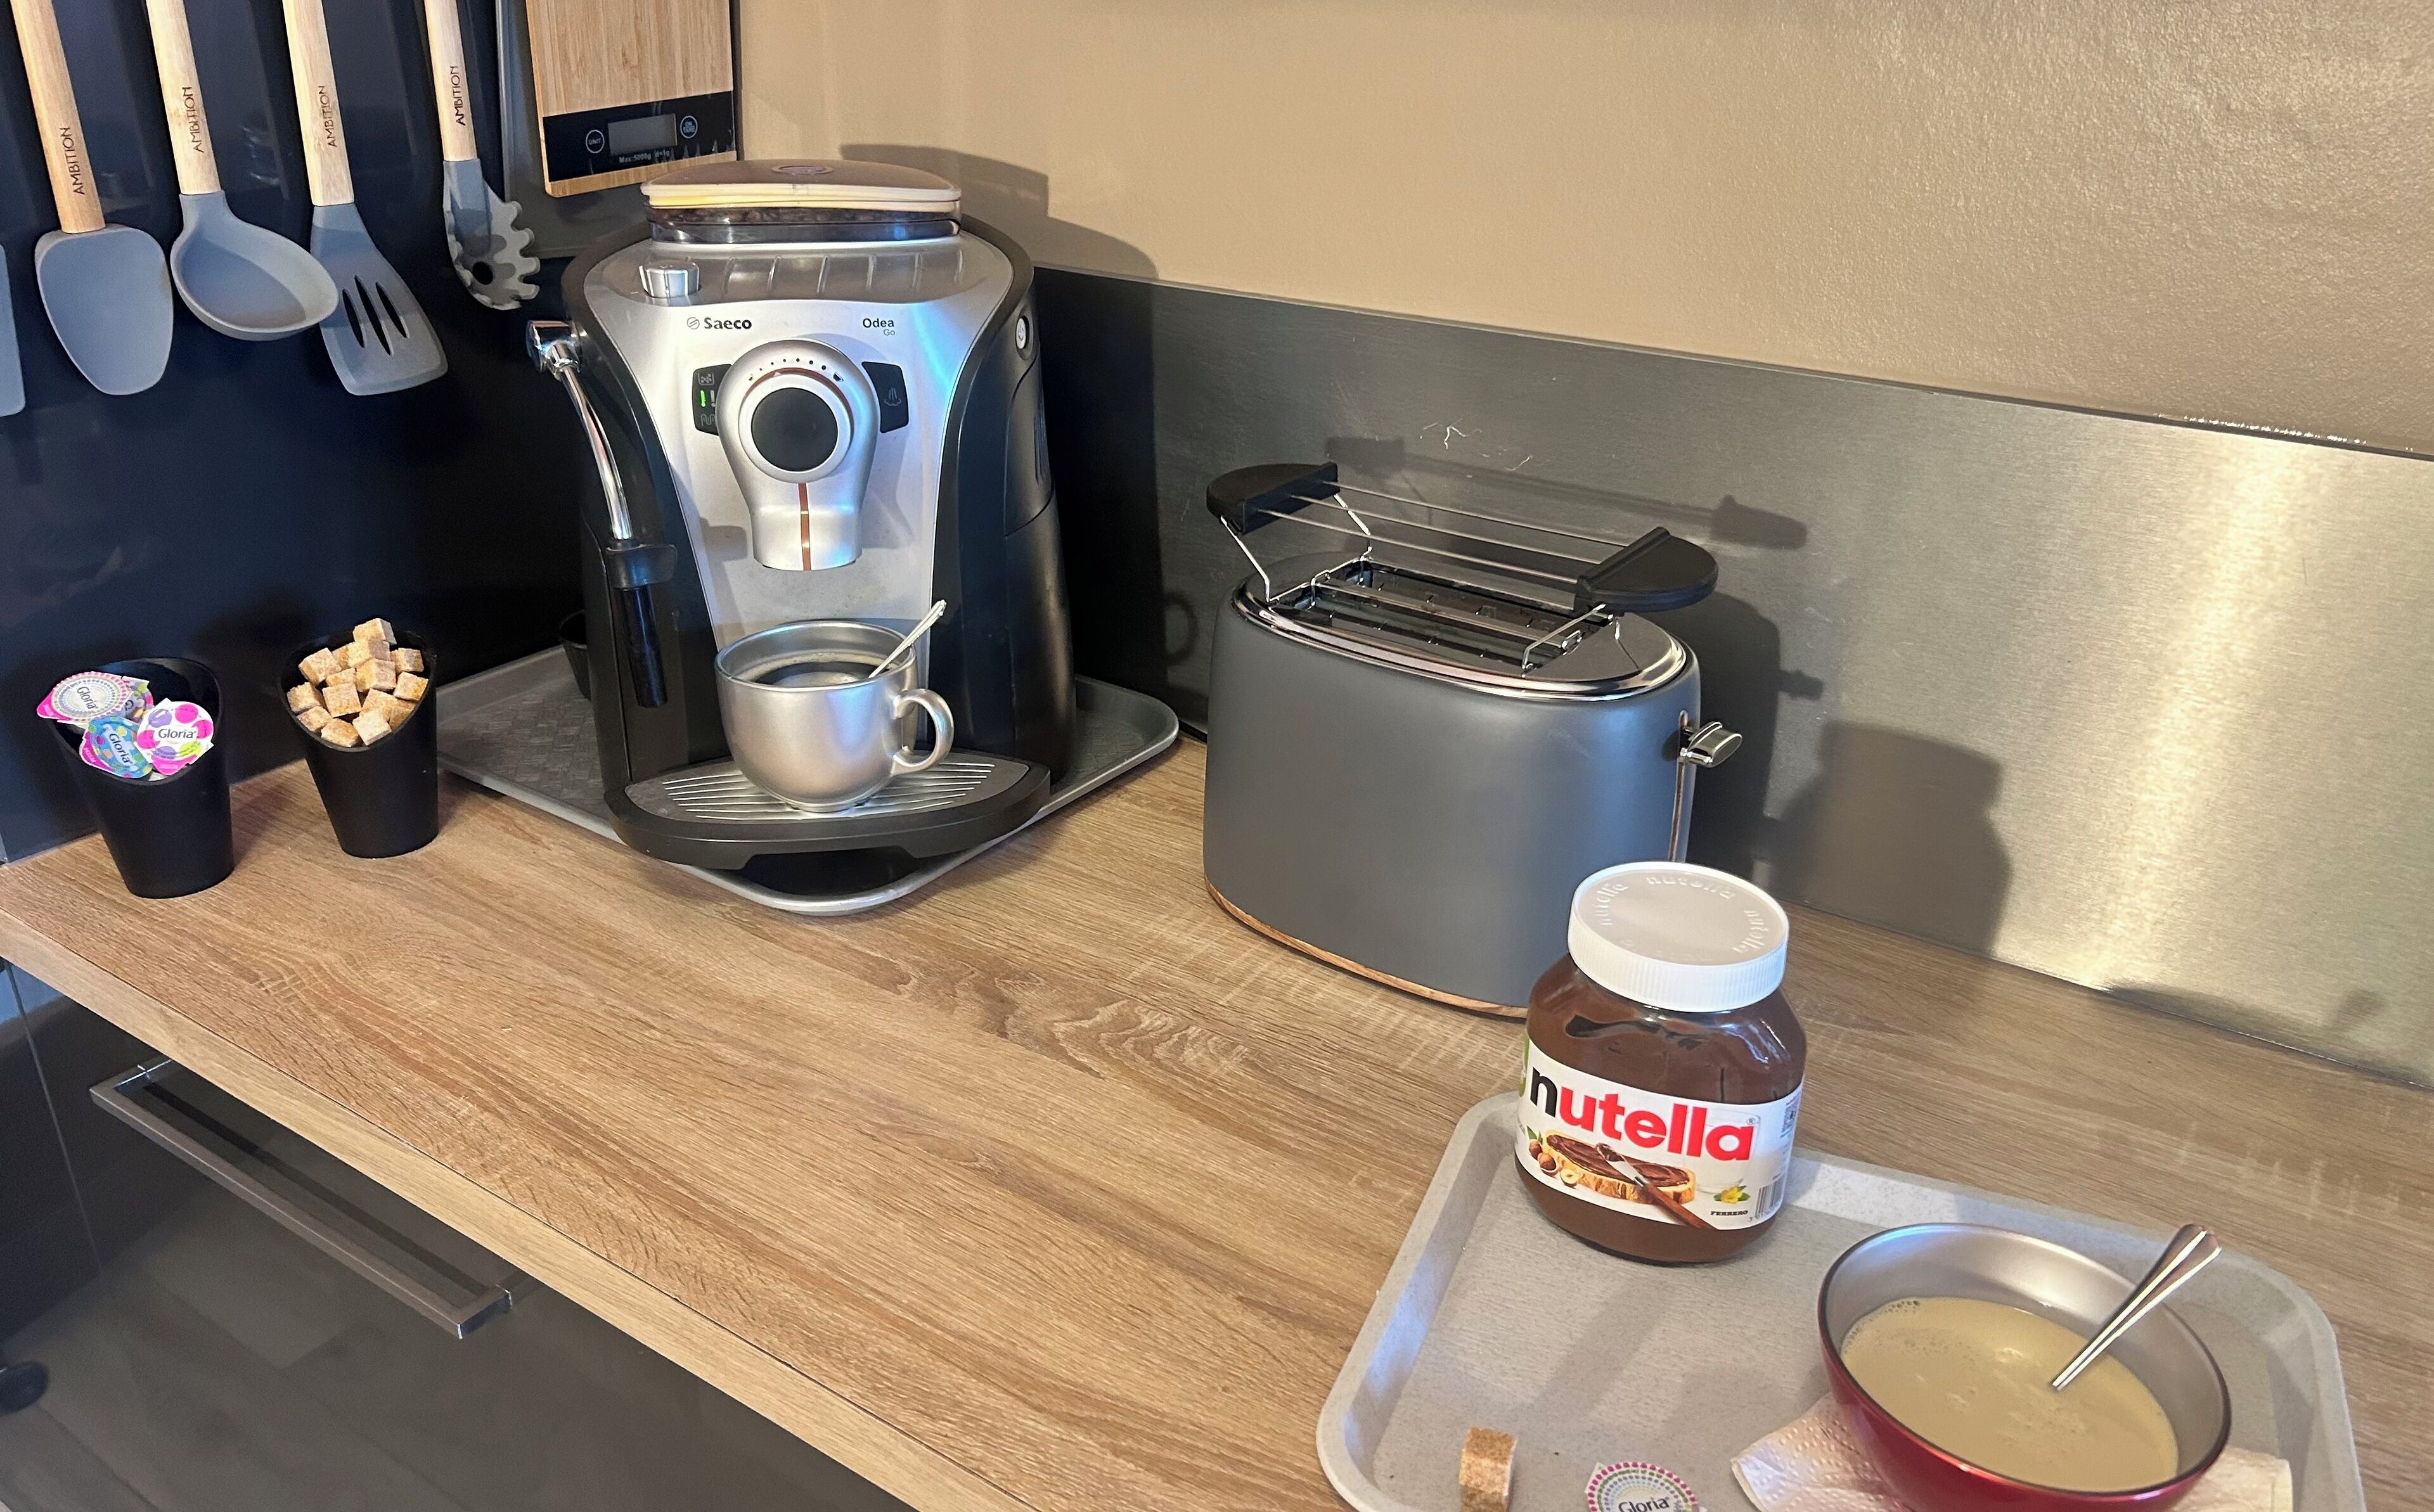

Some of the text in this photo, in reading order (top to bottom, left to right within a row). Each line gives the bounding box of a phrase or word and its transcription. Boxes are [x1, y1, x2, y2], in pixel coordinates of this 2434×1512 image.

[449, 65, 465, 126] AMBITION
[182, 86, 205, 153] AMBITION
[318, 85, 338, 148] AMBITION
[60, 127, 85, 195] AMBITION
[704, 317, 752, 330] Saeco
[862, 318, 894, 328] Odea
[77, 686, 97, 710] Gloria
[109, 733, 131, 764] Gloria
[158, 729, 194, 739] Gloria
[1529, 1067, 1755, 1162] nutella
[1618, 1496, 1670, 1512] Gloria
